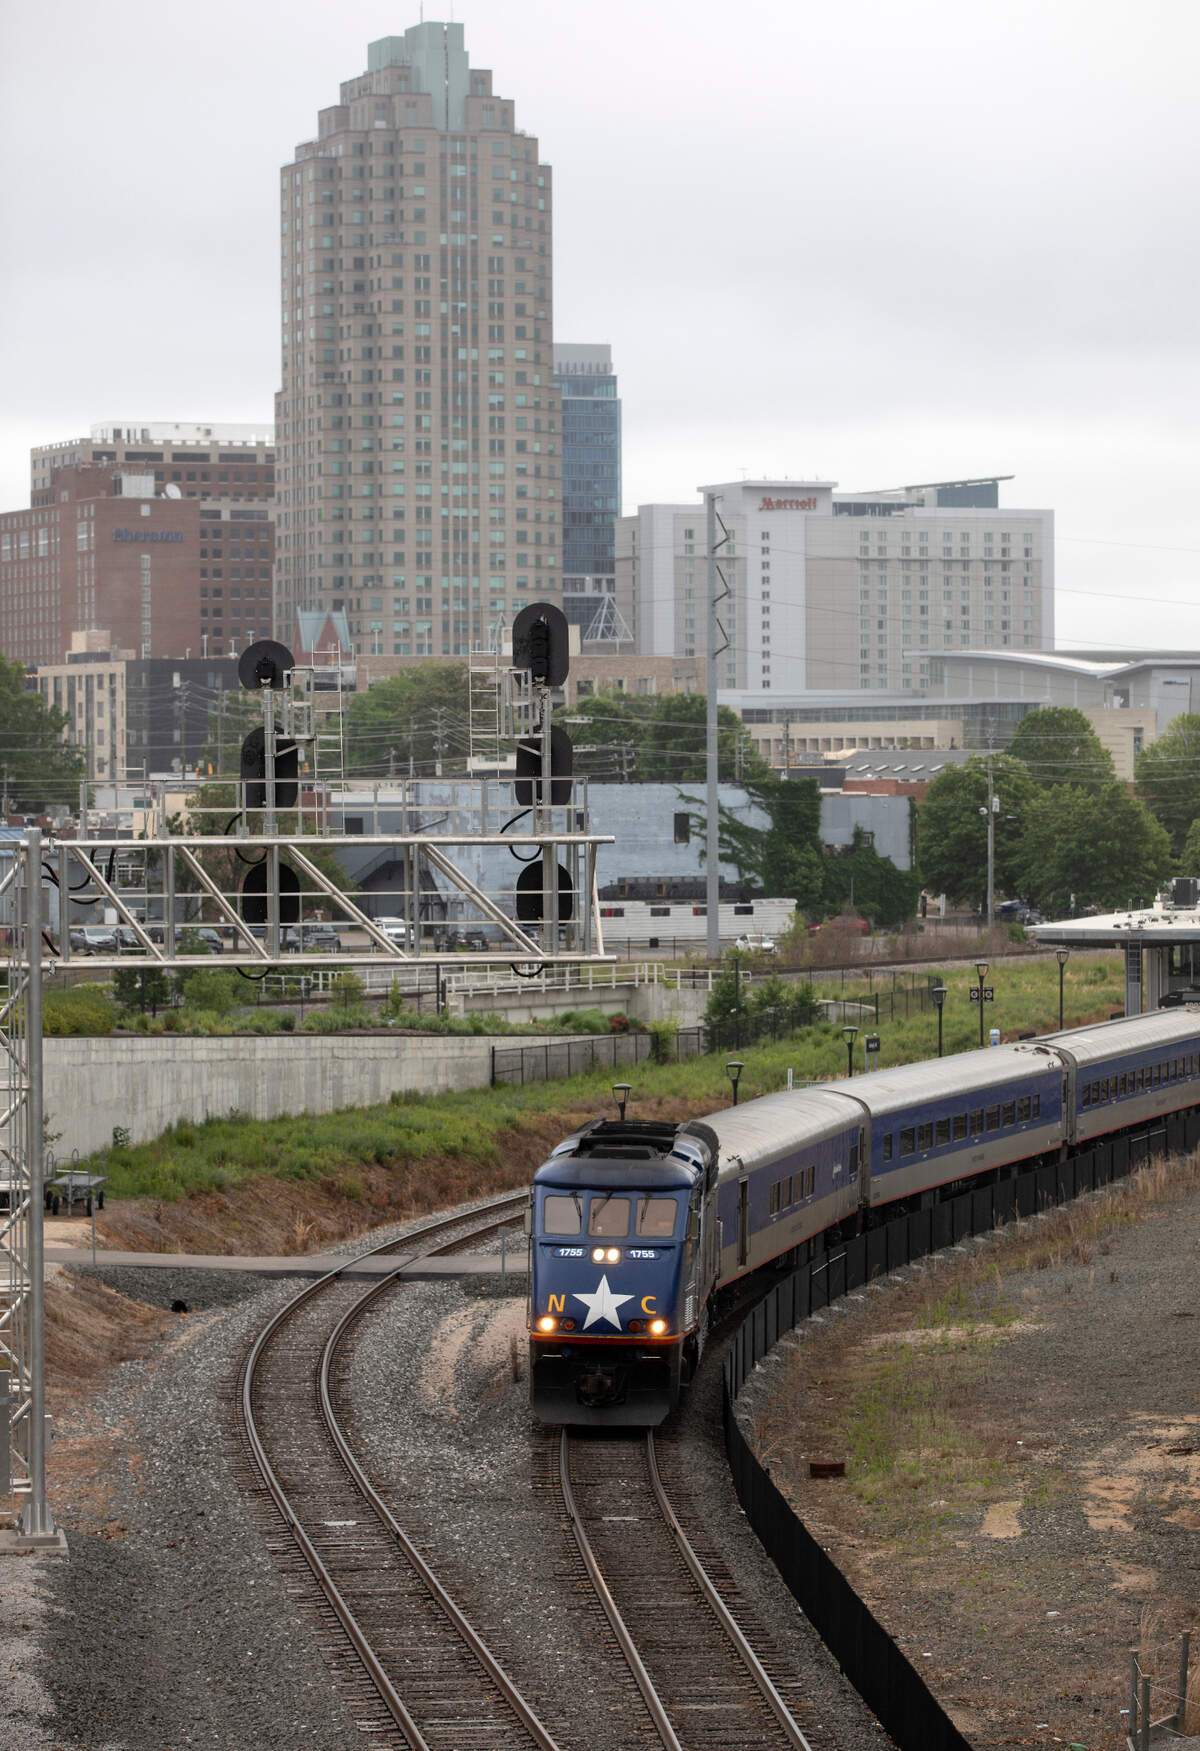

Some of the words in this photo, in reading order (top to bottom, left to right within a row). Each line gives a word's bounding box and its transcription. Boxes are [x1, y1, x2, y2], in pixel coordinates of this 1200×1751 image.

[759, 496, 817, 511] Marriott
[559, 1248, 583, 1257] 1755
[630, 1250, 655, 1258] 1755
[547, 1293, 566, 1312] N
[641, 1296, 657, 1314] C
